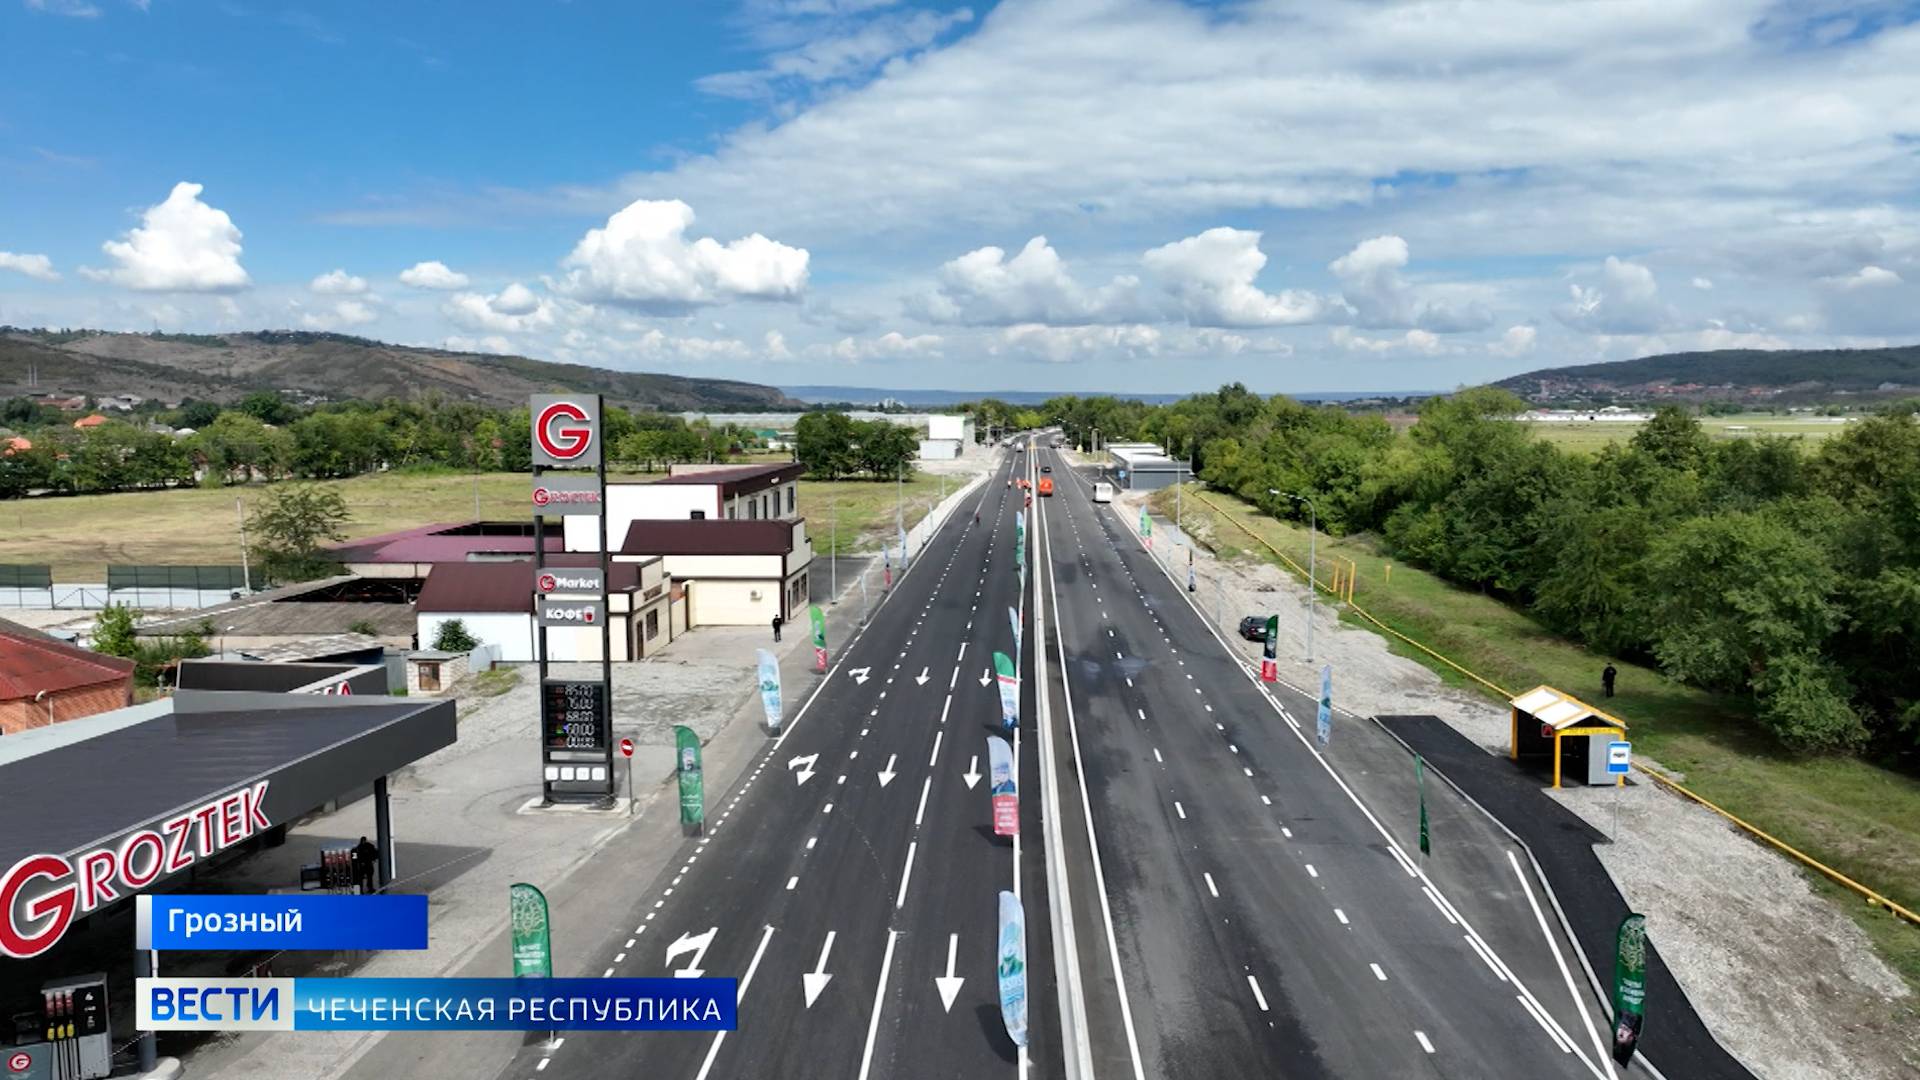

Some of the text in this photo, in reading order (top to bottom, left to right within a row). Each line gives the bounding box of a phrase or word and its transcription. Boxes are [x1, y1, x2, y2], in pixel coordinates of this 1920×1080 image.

[535, 401, 592, 459] G
[545, 608, 583, 621] КОФЕ
[0, 780, 271, 959] GROZTEK
